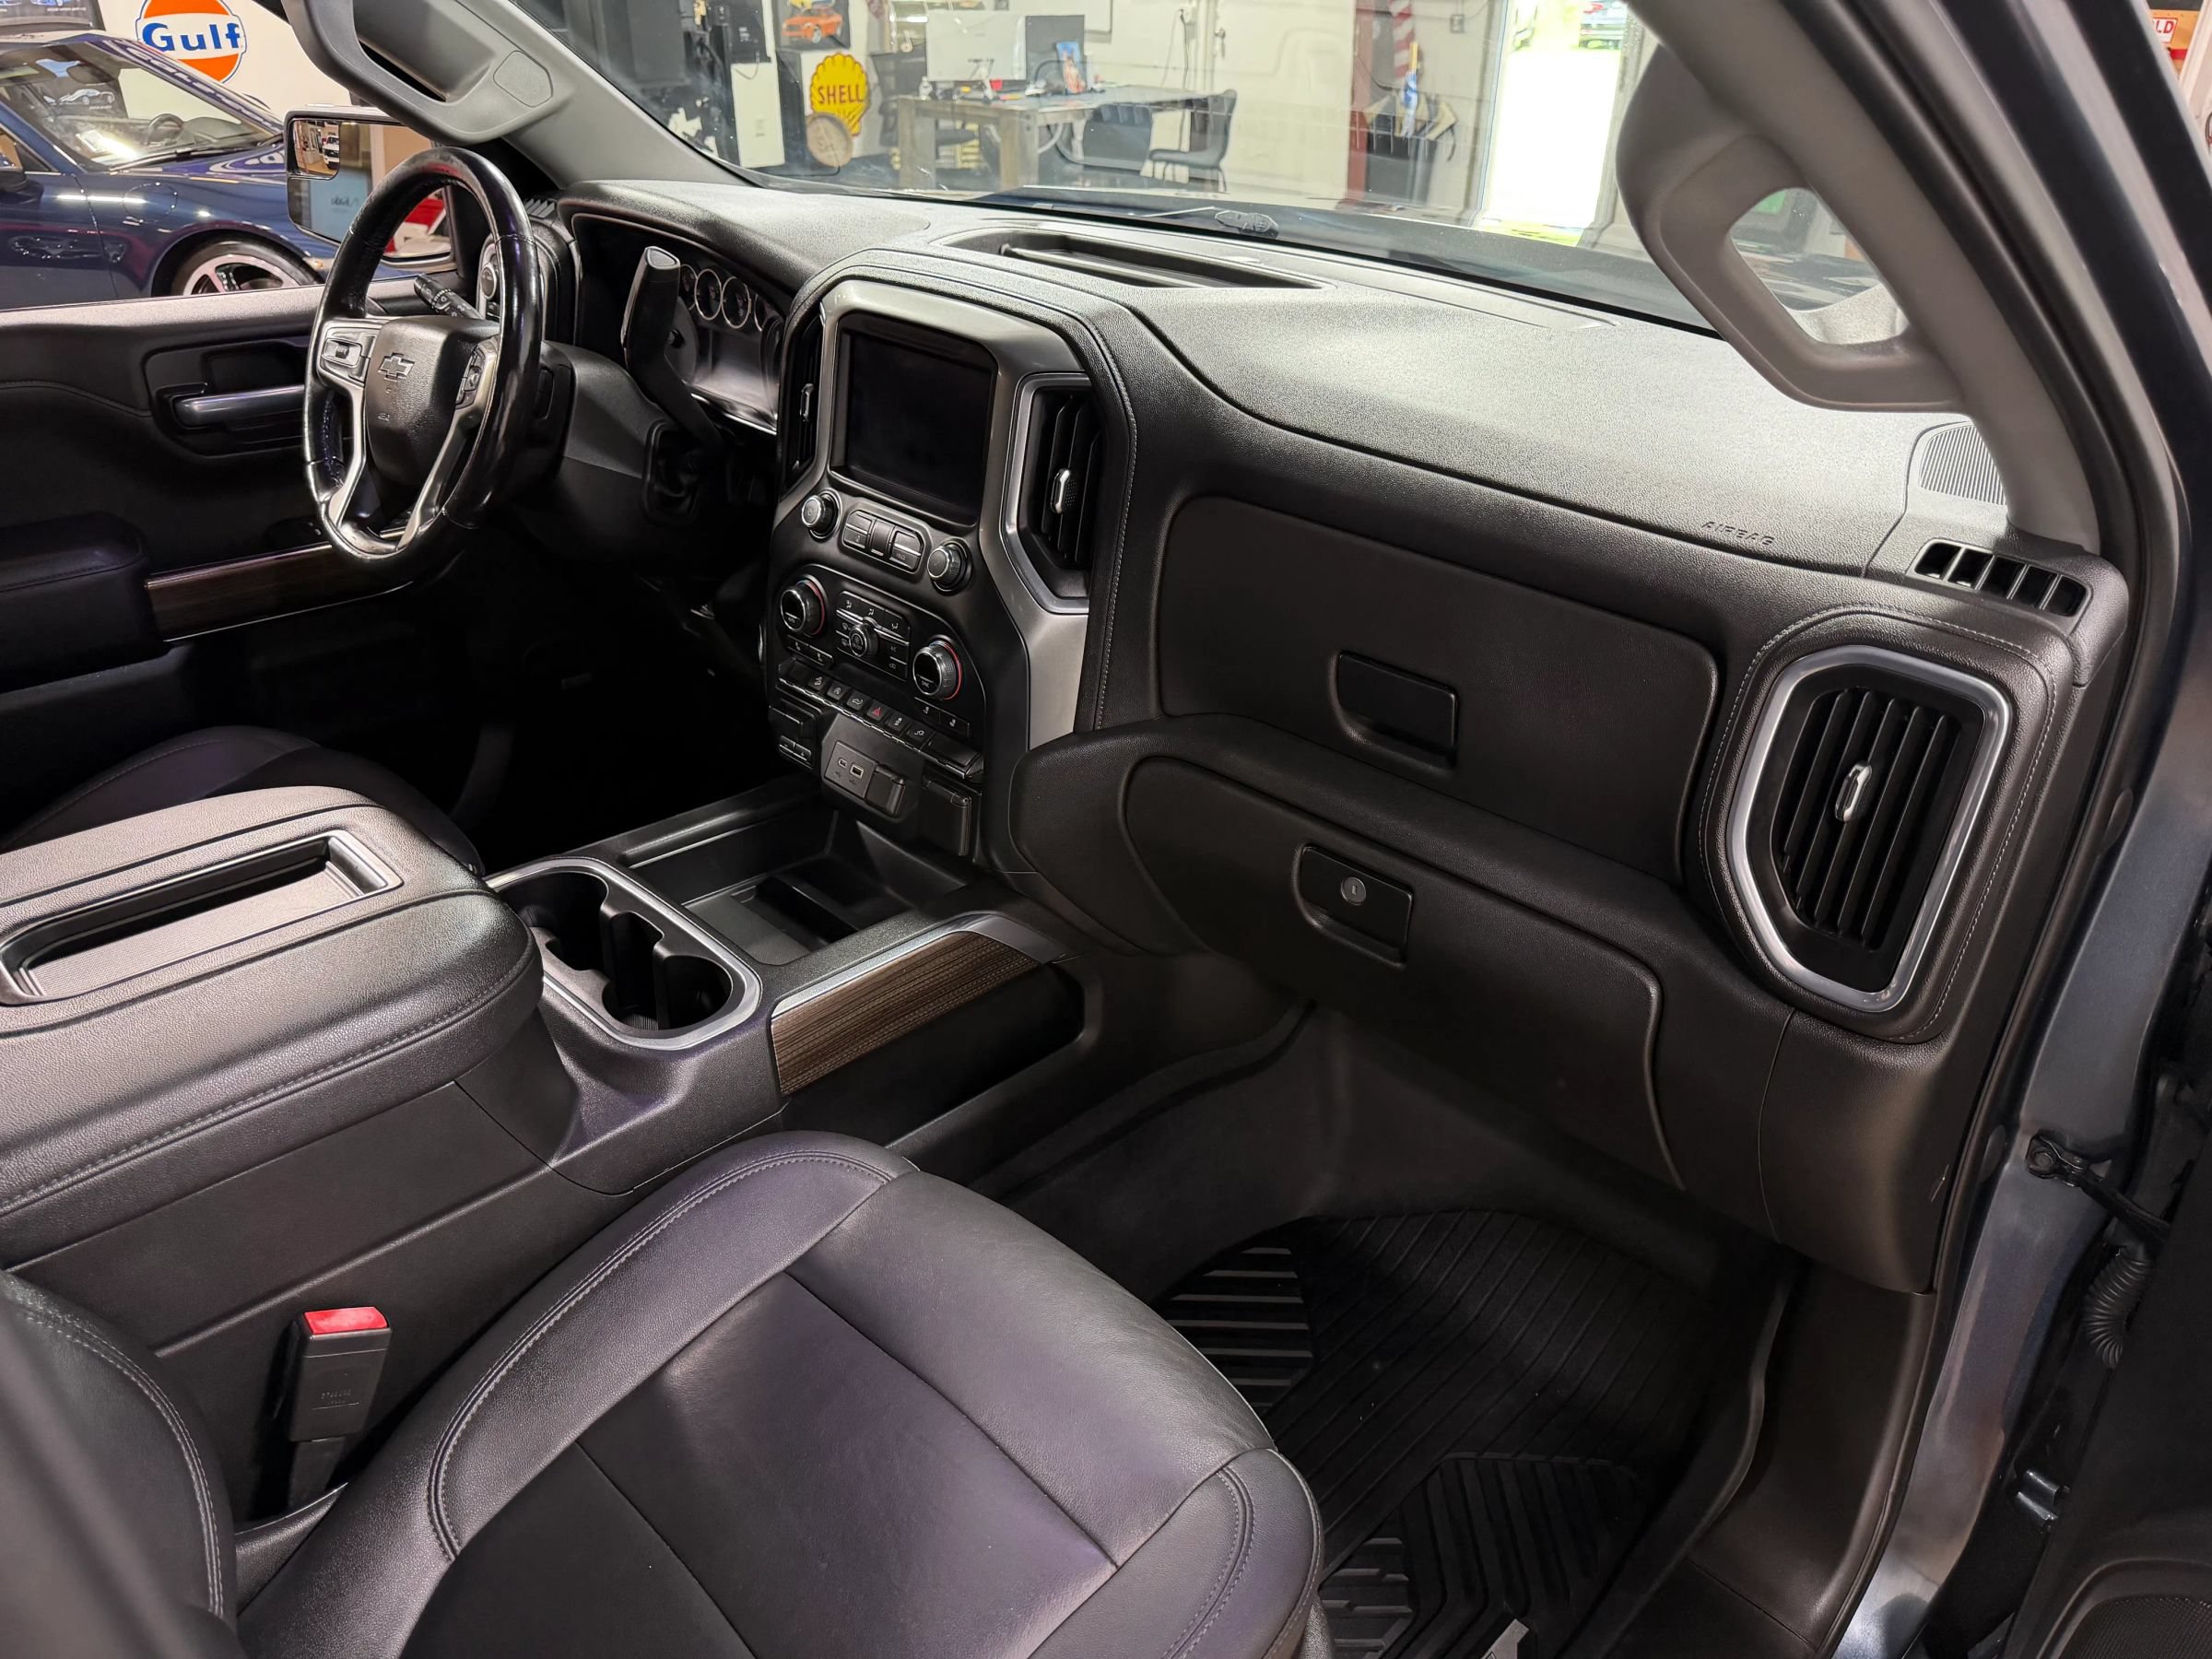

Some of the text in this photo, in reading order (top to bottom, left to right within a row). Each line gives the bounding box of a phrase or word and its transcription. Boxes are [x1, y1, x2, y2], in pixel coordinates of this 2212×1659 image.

[142, 22, 241, 53] Gulf
[2152, 19, 2175, 34] LD
[818, 84, 865, 105] SHELL
[1701, 521, 1776, 547] AIRBAG
